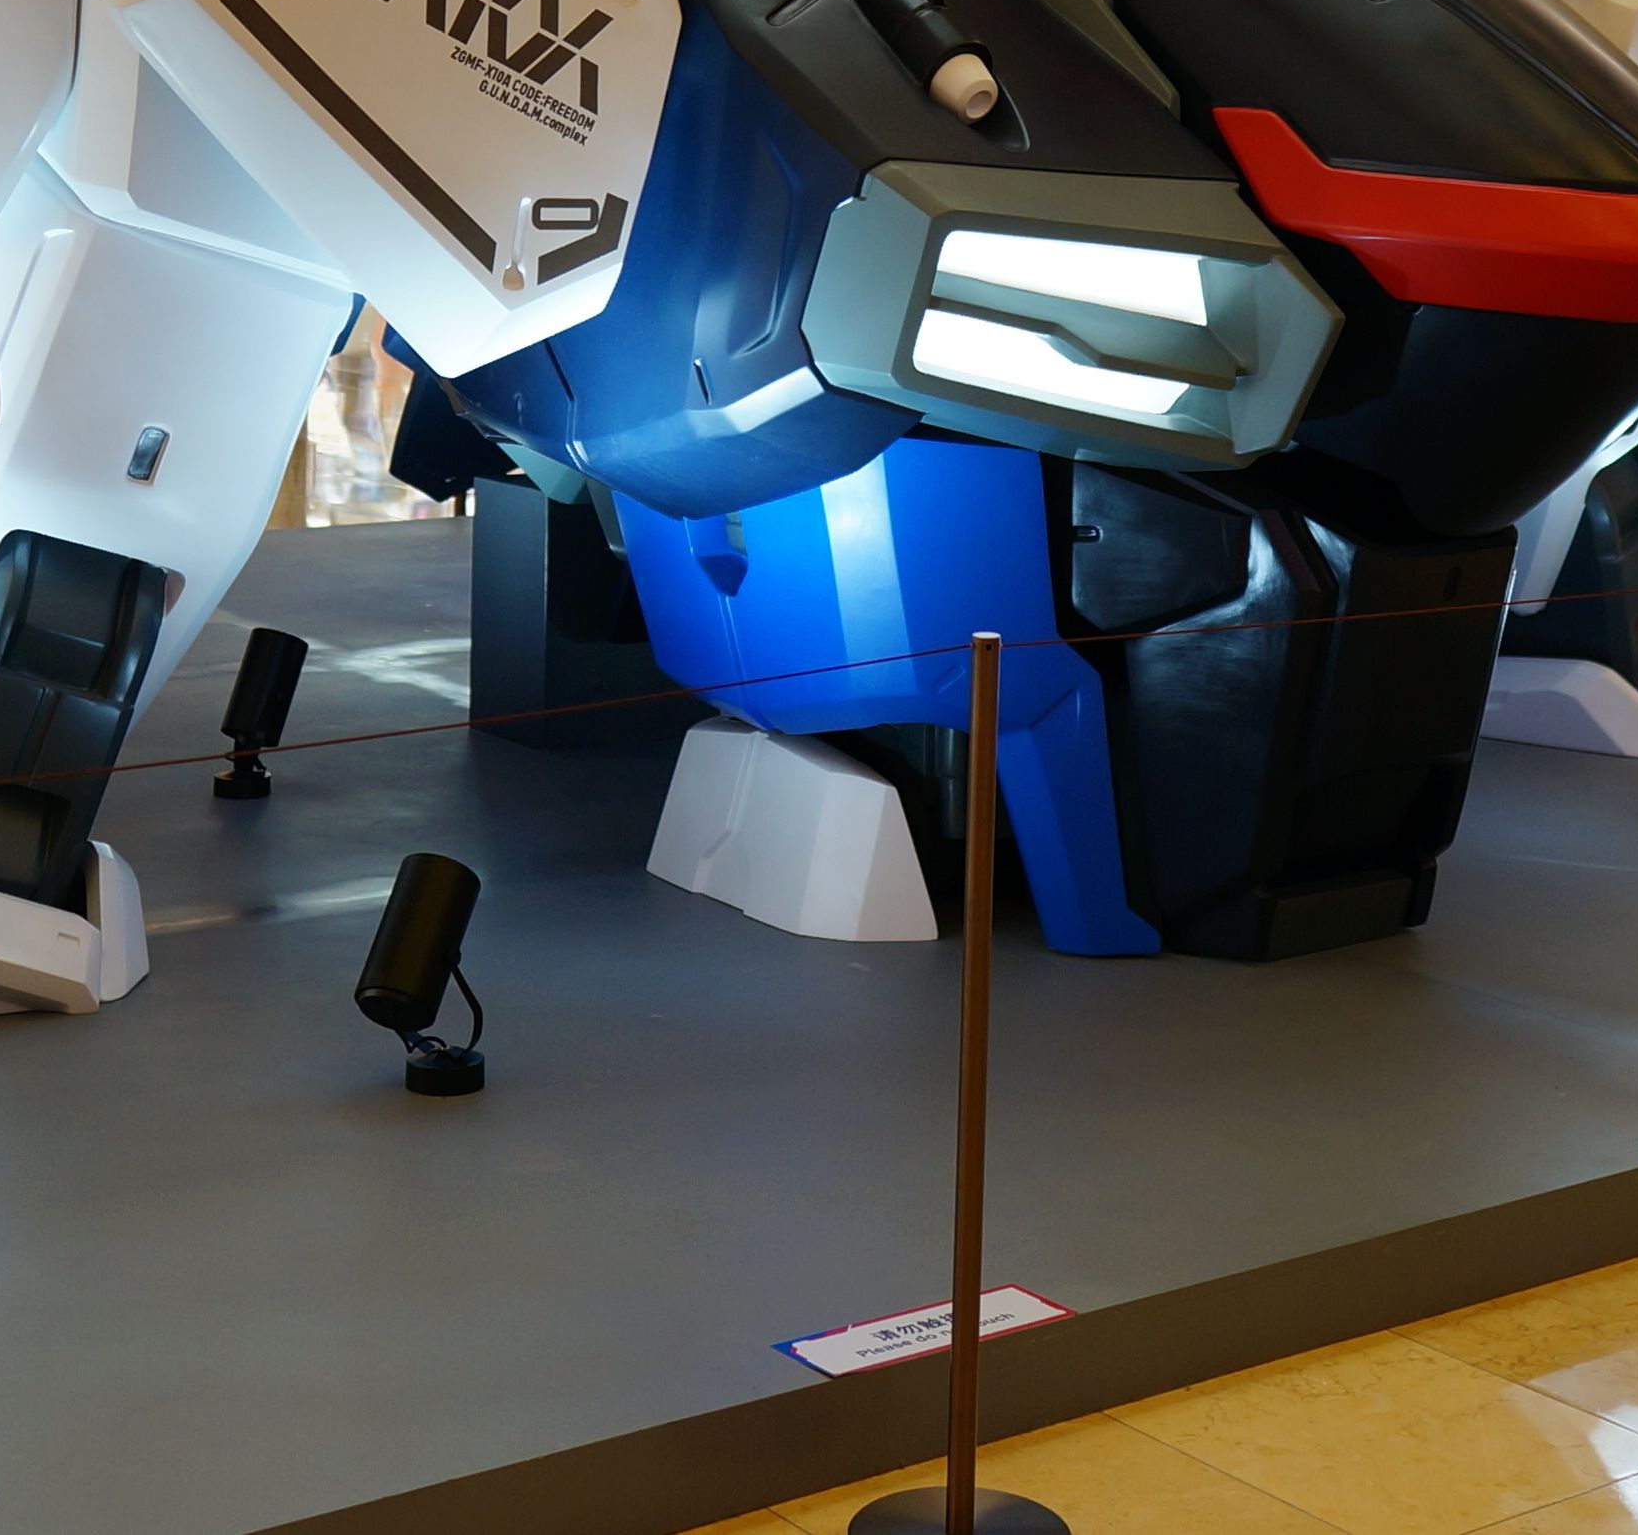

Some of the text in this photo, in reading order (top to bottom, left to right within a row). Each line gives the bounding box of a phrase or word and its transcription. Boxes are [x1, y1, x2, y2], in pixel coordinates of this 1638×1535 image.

[450, 46, 596, 133] ZGMF-X10A CODE:FREEDOM
[478, 79, 588, 147] G.U.N.D.A.M.complex
[856, 1312, 1016, 1358] Please do ouch
